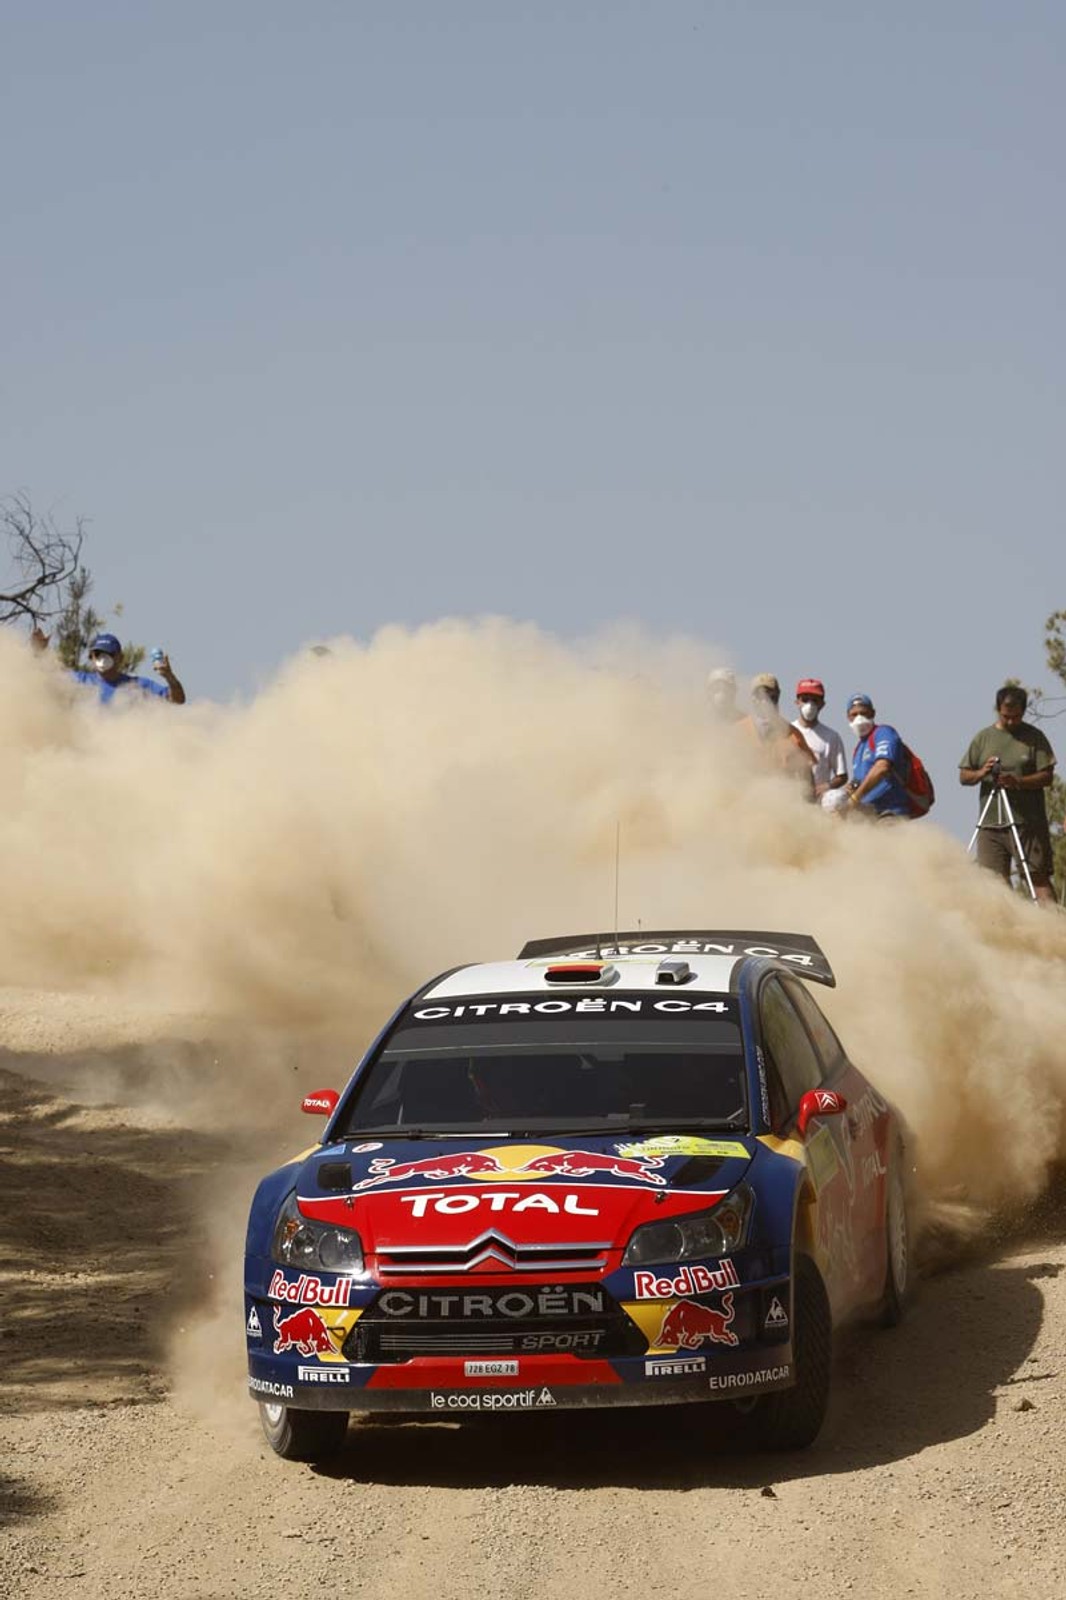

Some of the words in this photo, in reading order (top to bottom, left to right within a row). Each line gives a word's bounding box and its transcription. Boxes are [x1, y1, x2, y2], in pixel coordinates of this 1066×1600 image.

[744, 947, 814, 967] C4
[413, 998, 642, 1019] CITROËN
[653, 1000, 728, 1013] C4
[400, 1192, 599, 1217] TOTAL
[378, 1286, 604, 1318] CITROËN
[521, 1333, 606, 1350] SPORT
[297, 1365, 350, 1383] PIRELLI
[645, 1357, 706, 1376] PIRELLI
[709, 1365, 791, 1390] EURODATACAR
[431, 1392, 446, 1408] le
[447, 1395, 481, 1410] coq
[482, 1389, 536, 1410] sportif
